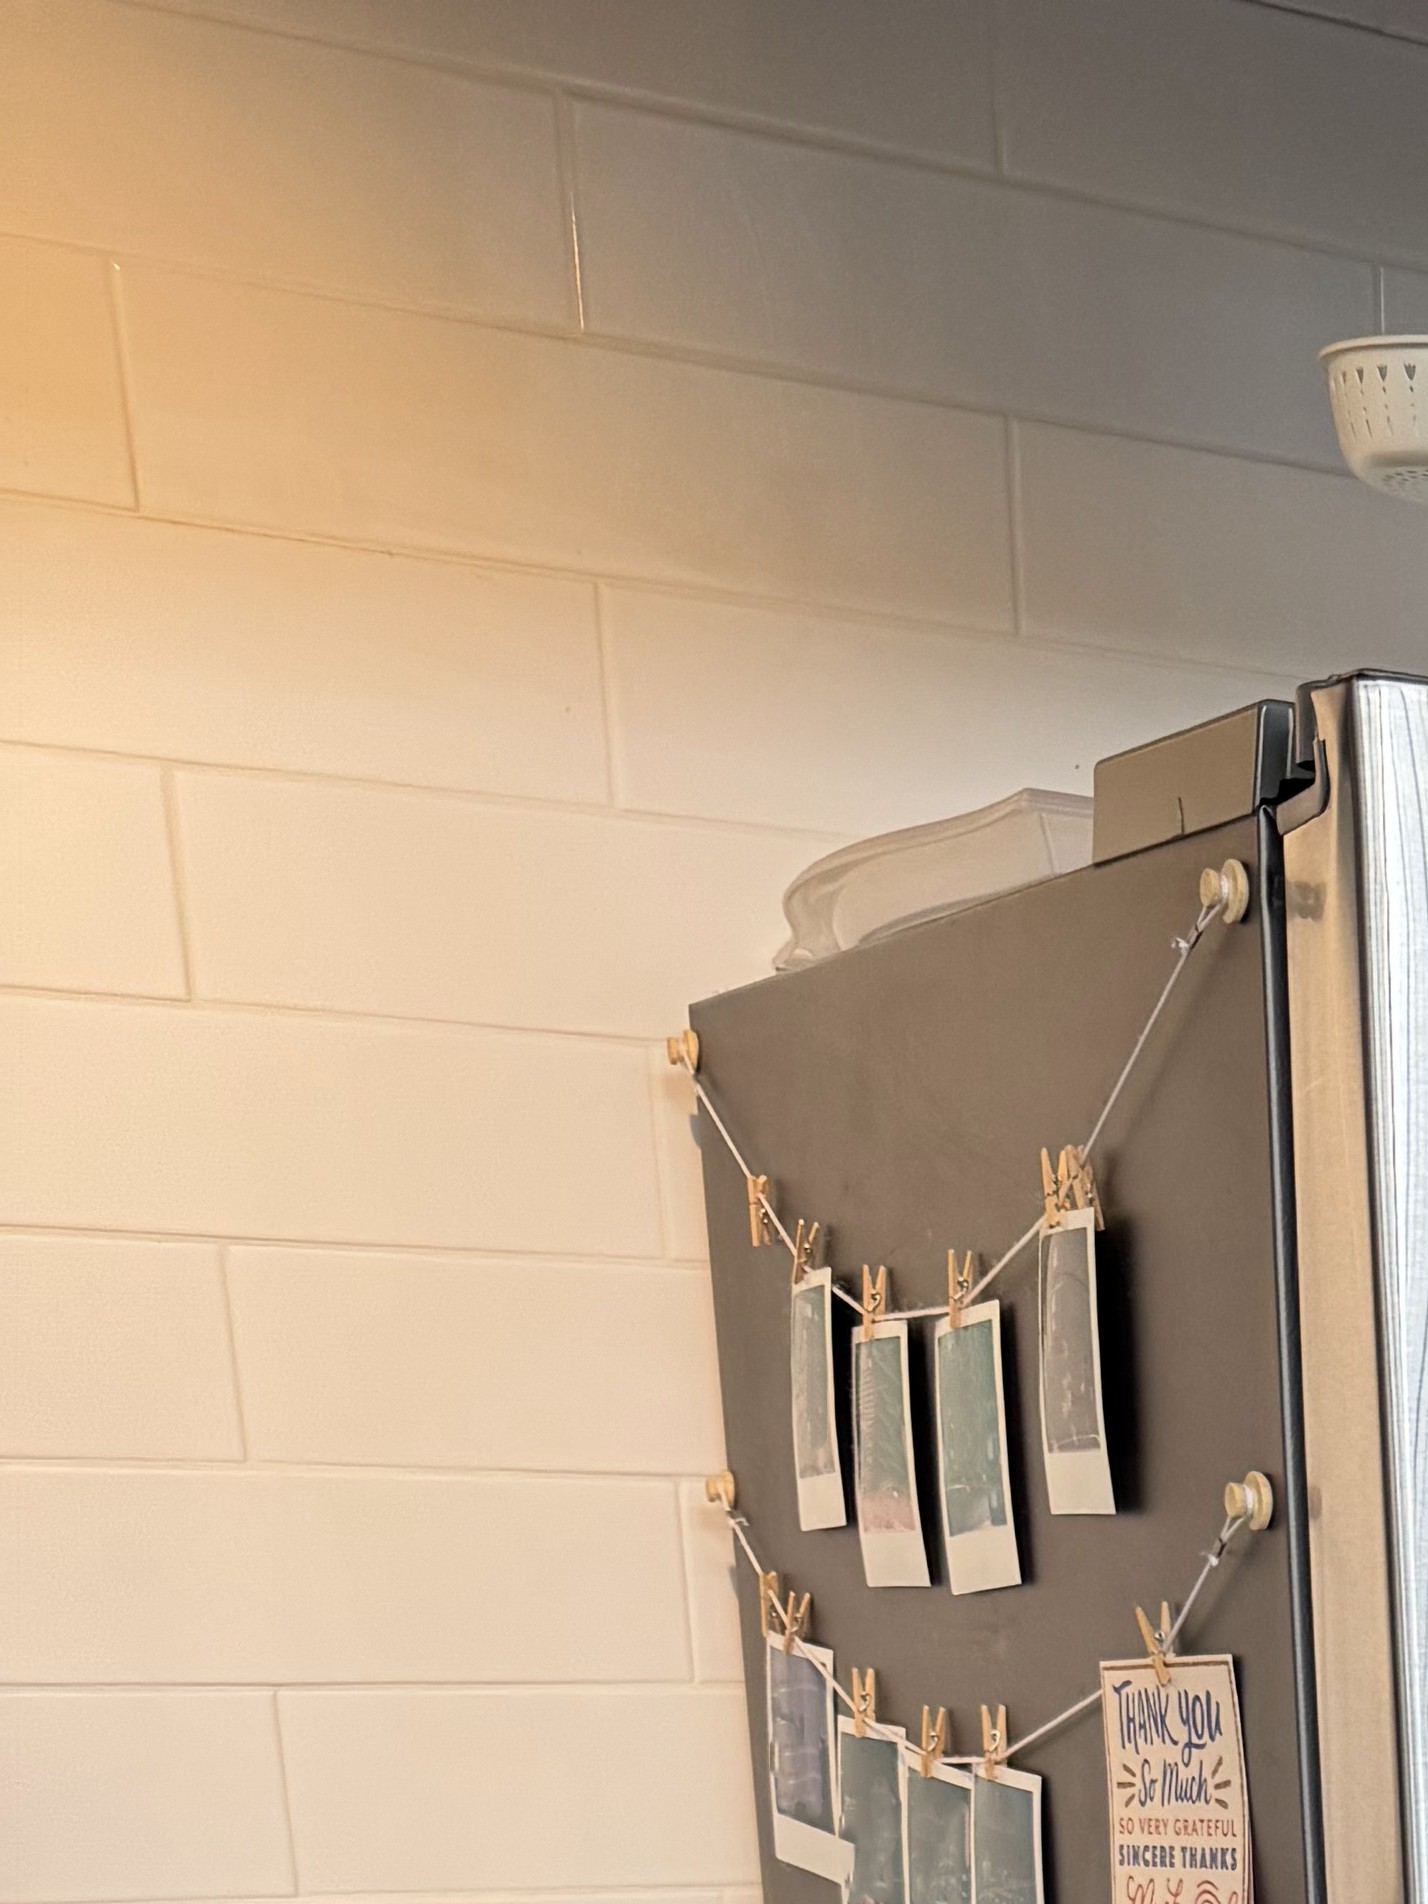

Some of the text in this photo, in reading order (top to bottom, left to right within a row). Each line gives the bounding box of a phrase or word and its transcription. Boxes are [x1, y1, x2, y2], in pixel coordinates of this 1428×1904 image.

[1112, 1680, 1179, 1756] THANK
[1138, 1758, 1212, 1807] So Much
[1118, 1817, 1237, 1838] SO VERY GRATEFUL
[1118, 1844, 1238, 1871] SINCERE THANKS
